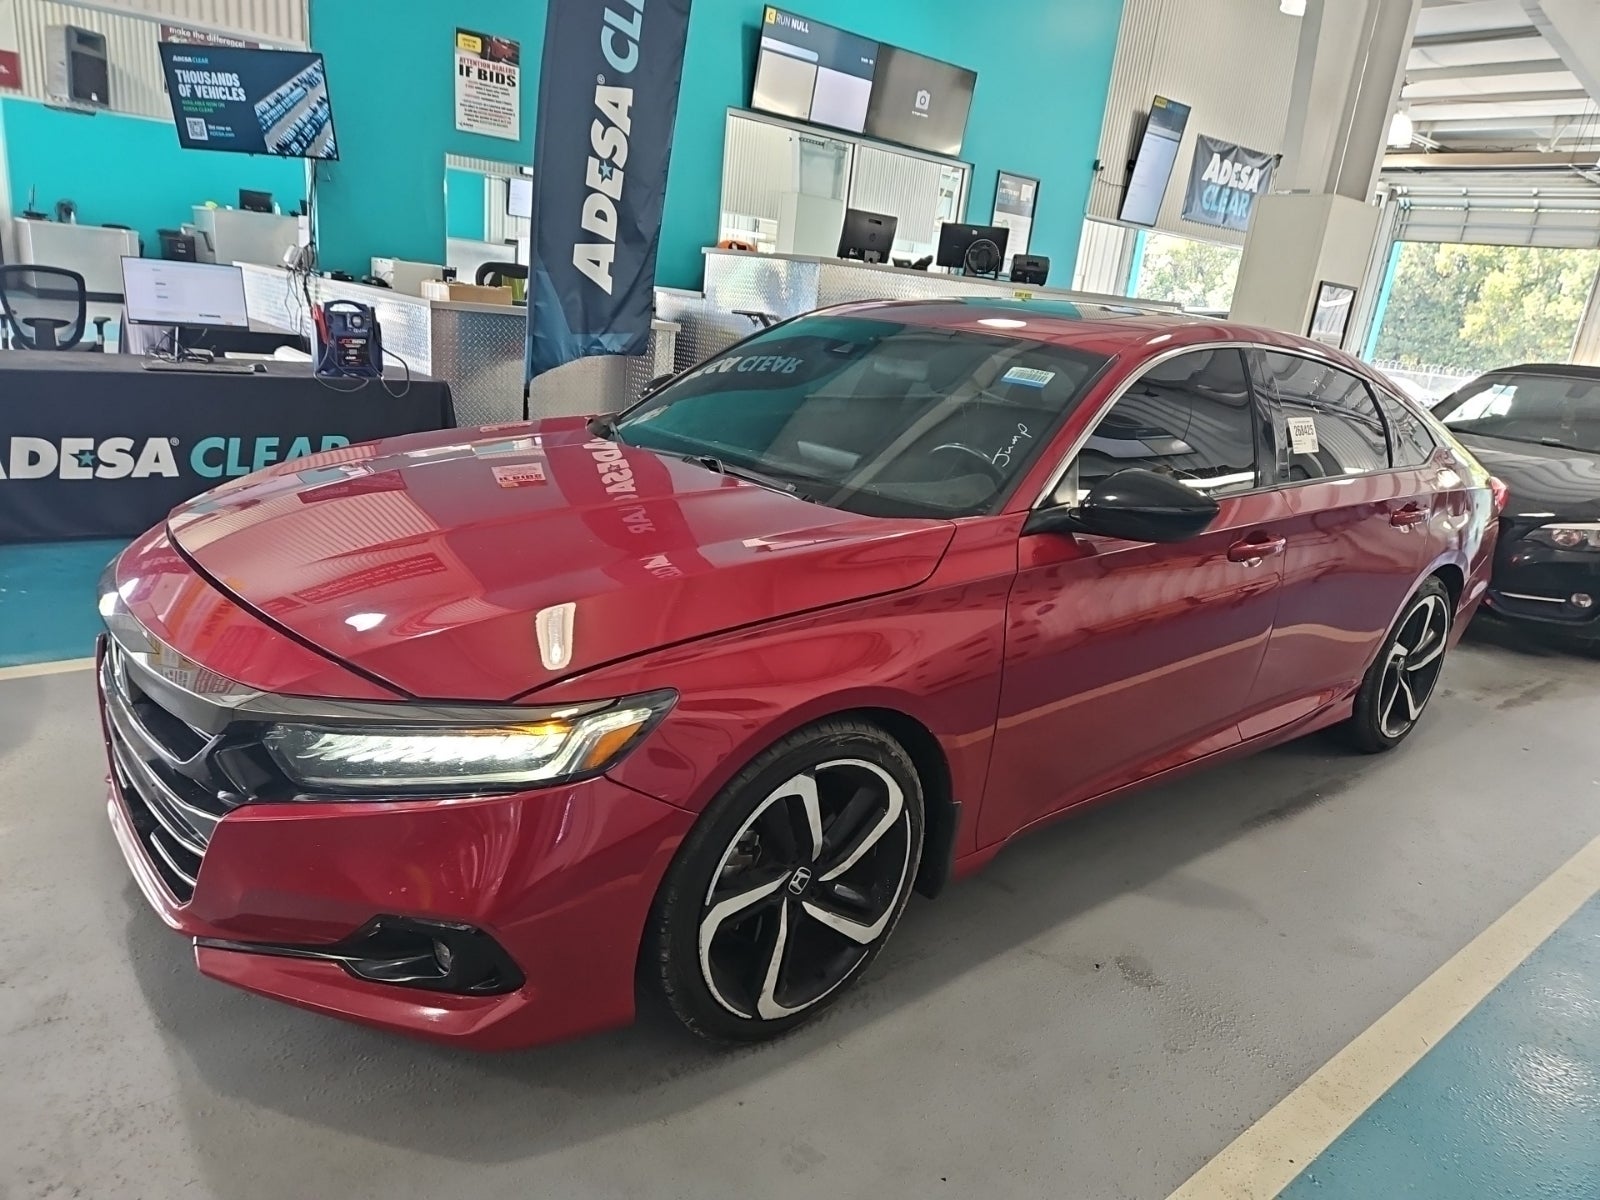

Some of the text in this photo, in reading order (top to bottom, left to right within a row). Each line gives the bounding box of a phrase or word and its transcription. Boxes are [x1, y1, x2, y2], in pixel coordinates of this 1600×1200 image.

[169, 27, 191, 37] make
[192, 29, 205, 40] the
[776, 12, 792, 26] RUN
[791, 17, 809, 34] NULL
[174, 69, 241, 88] THOUSANDS
[459, 64, 517, 88] IF BIDS
[178, 84, 247, 102] OF VEHICLES
[1201, 152, 1261, 194] ADESA
[1201, 184, 1250, 218] CLEAR
[1293, 424, 1315, 437] 268425
[992, 422, 1033, 468] Jump
[0, 436, 180, 480] DESA
